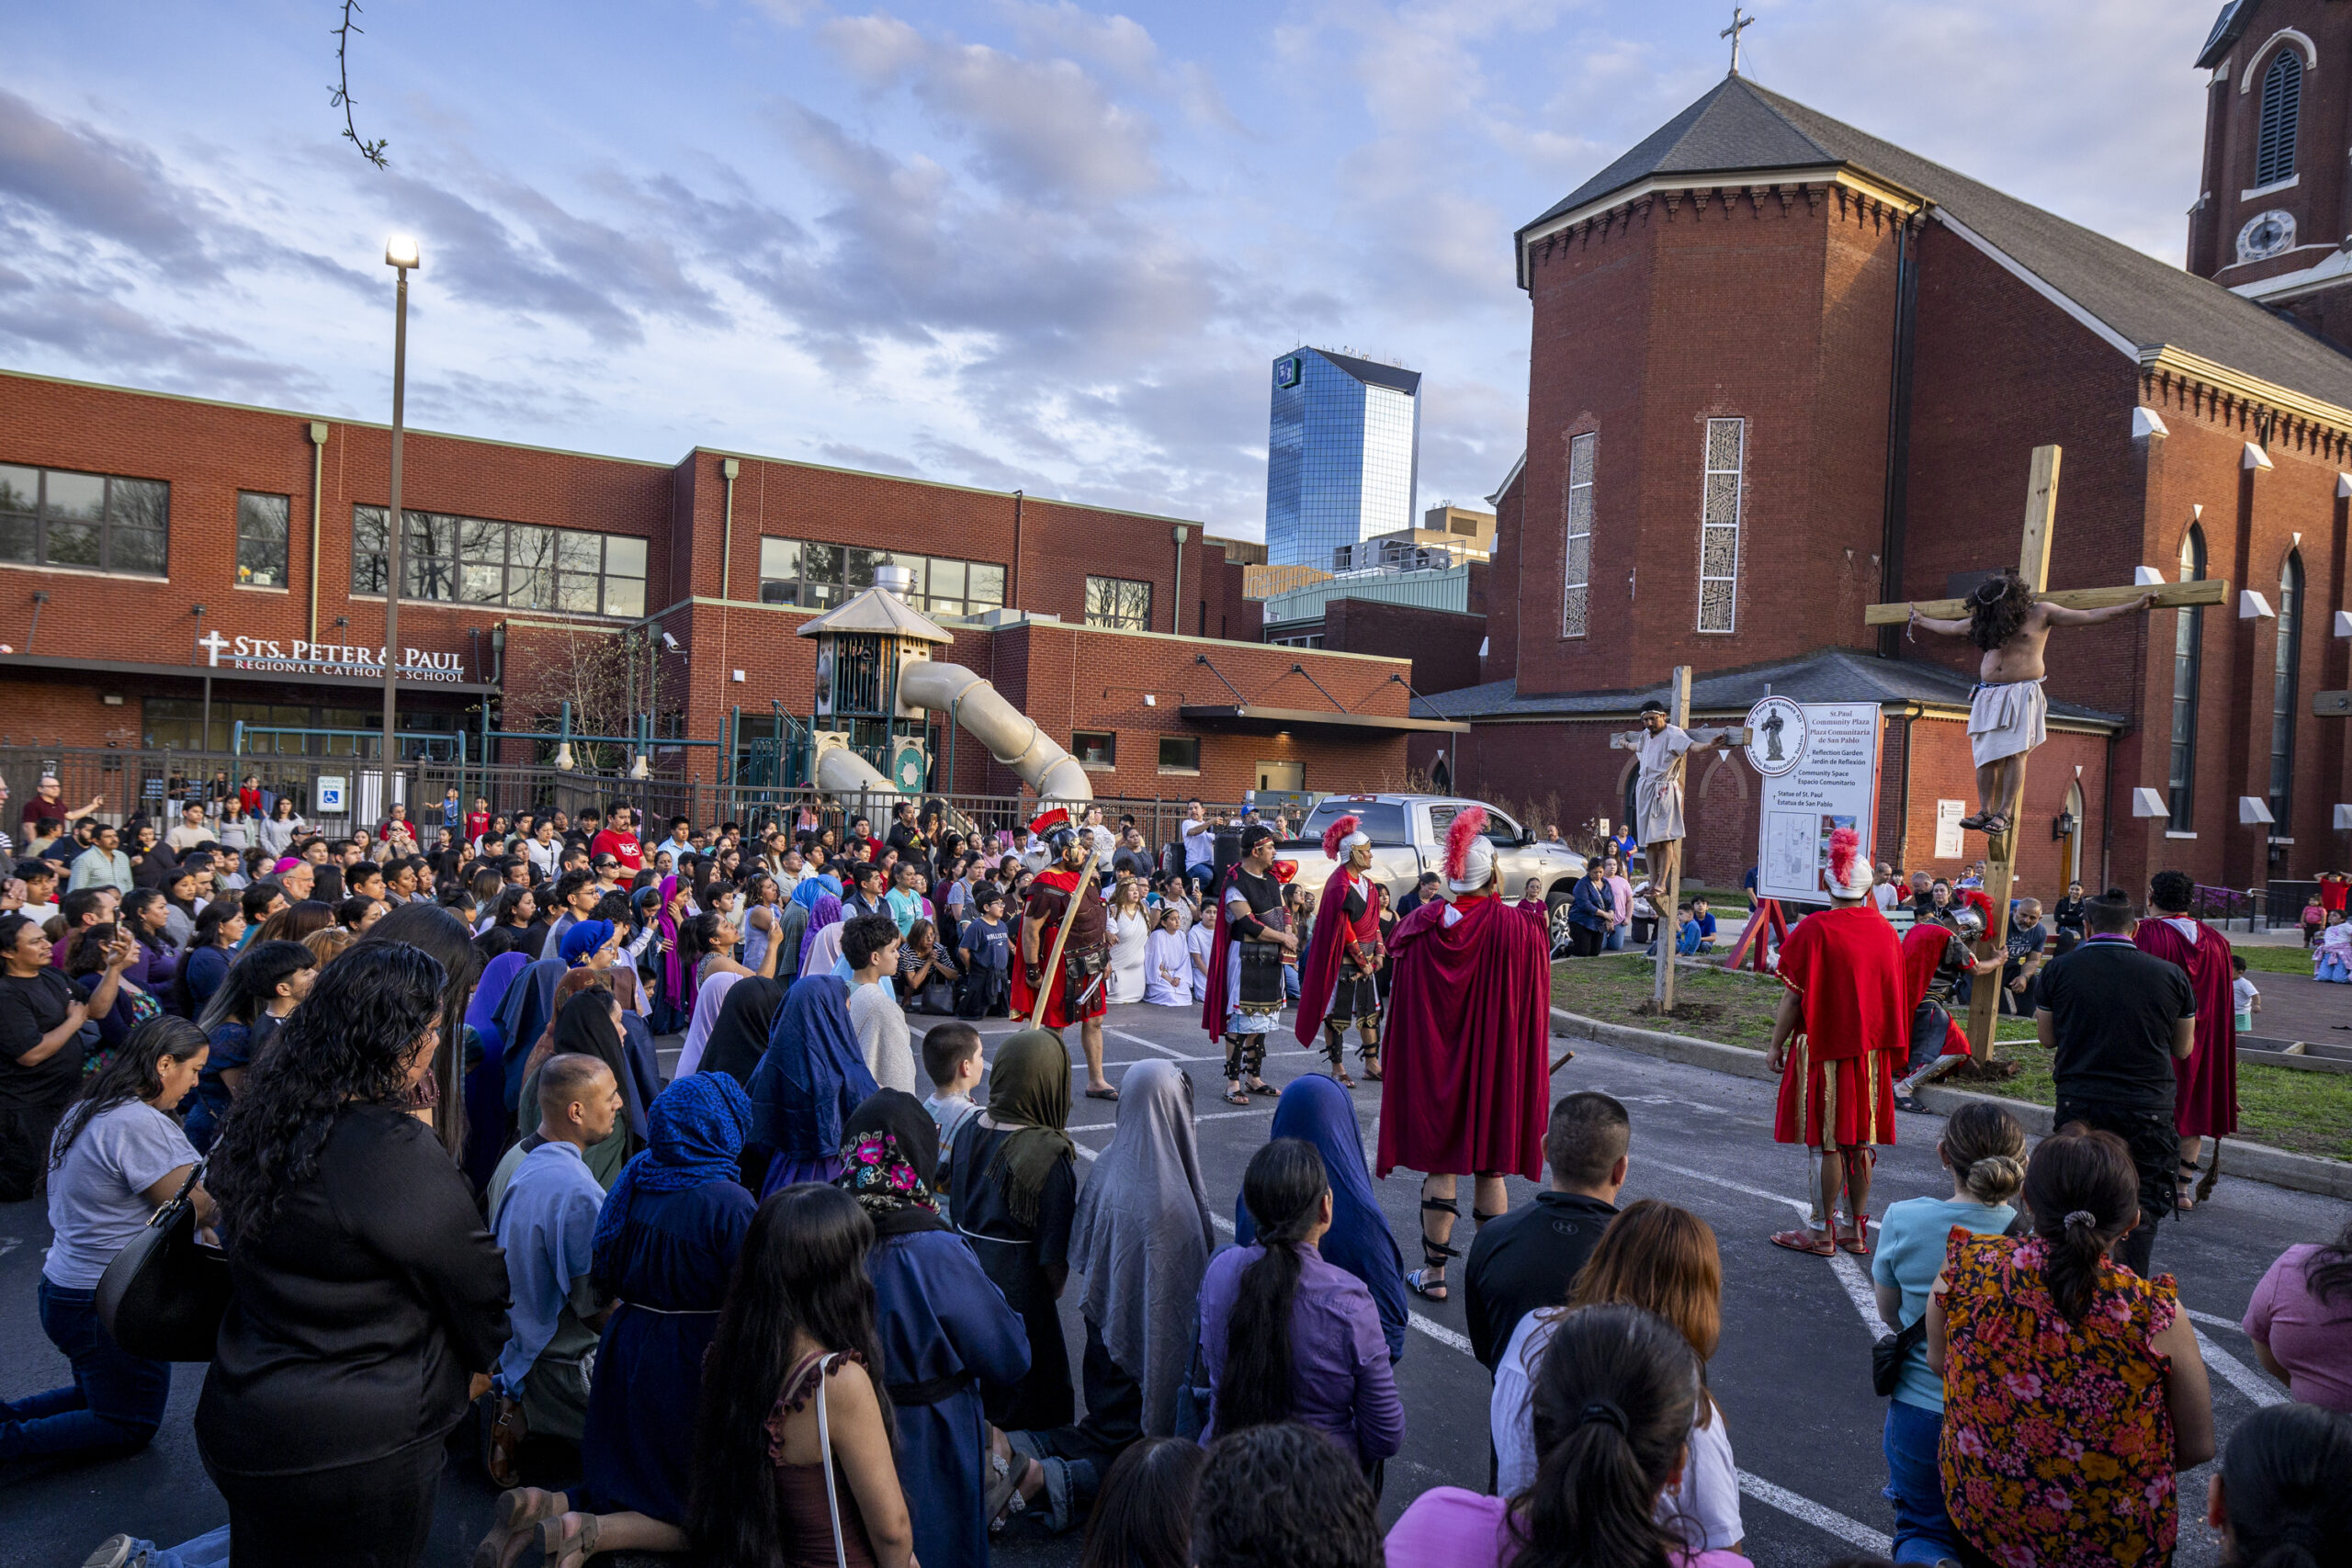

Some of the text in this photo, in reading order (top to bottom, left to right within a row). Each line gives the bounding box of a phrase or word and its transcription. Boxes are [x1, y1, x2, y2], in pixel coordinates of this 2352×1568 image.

[234, 636, 287, 660] STS.
[291, 639, 375, 665] PETER
[404, 648, 464, 671] PAUL
[235, 660, 316, 674] REGIONAL
[406, 671, 463, 682] SCHOOL
[1812, 718, 1851, 727] Community
[1831, 771, 1849, 779] Space
